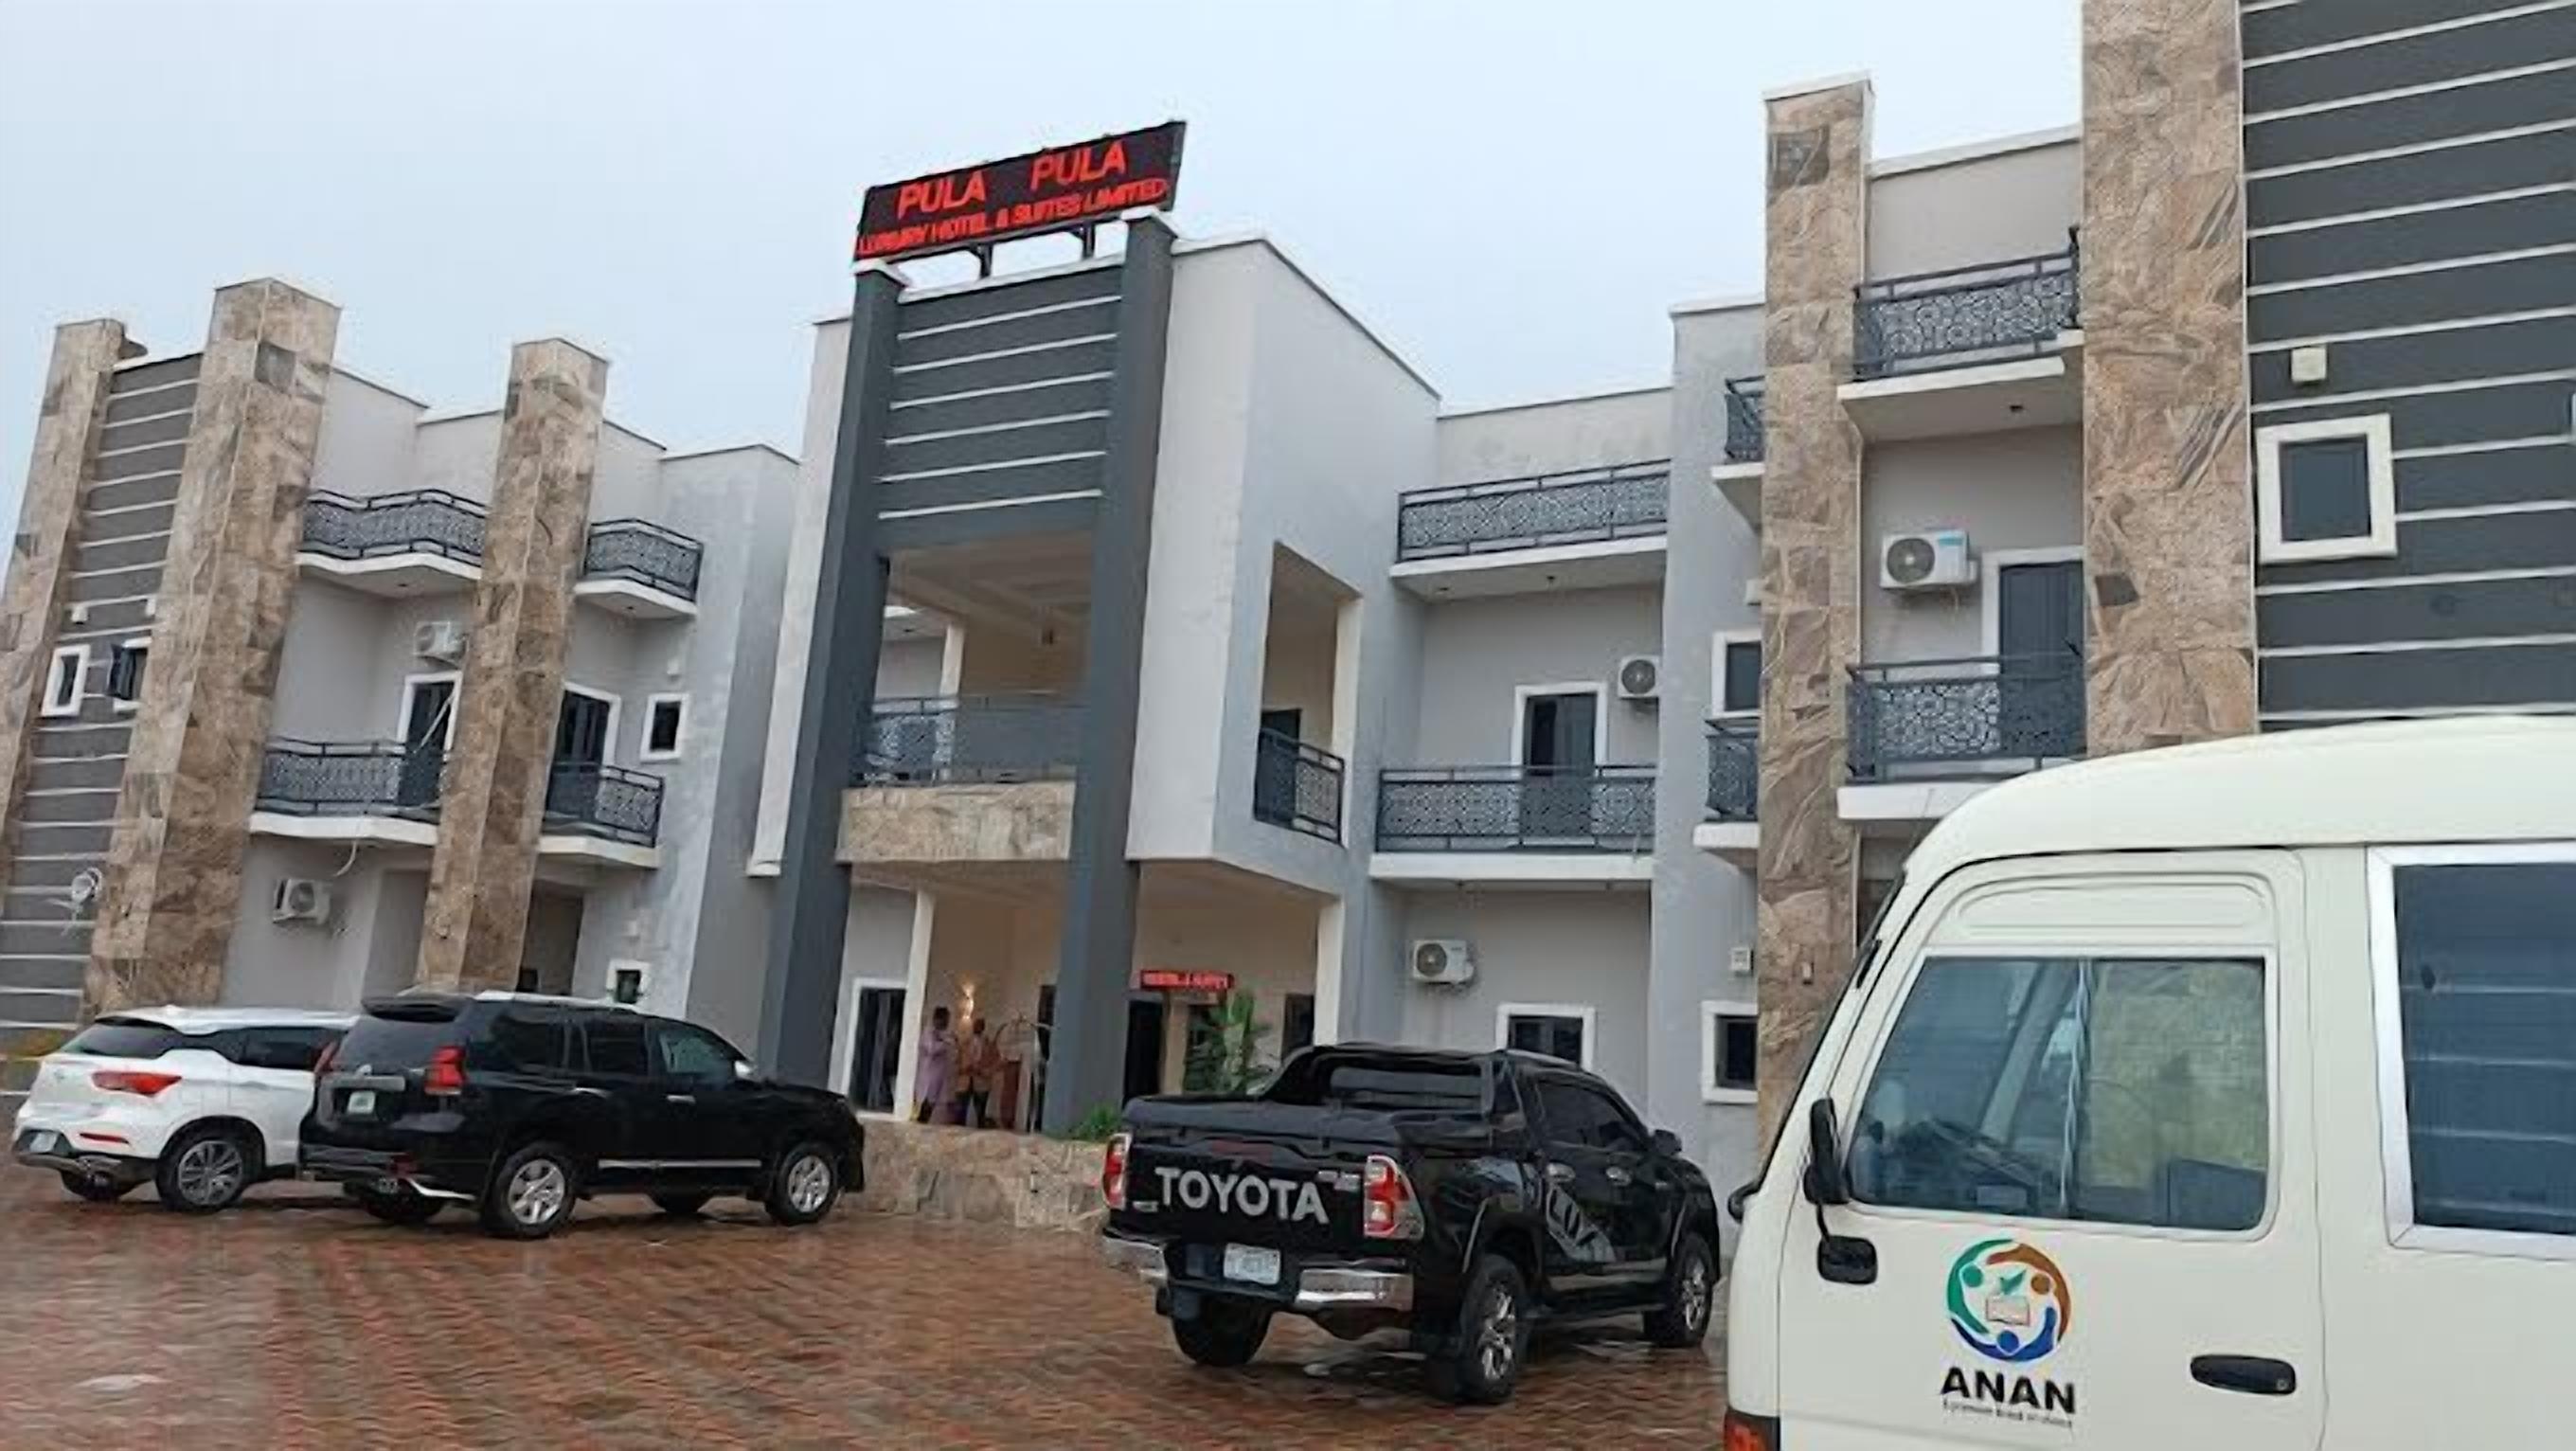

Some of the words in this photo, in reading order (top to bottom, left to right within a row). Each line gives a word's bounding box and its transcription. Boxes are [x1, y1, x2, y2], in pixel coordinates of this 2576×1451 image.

[897, 170, 986, 220] PULA
[1029, 139, 1127, 191] PULA
[1154, 1166, 1330, 1224] TOYOTA
[1941, 1366, 2076, 1414] ANAN
